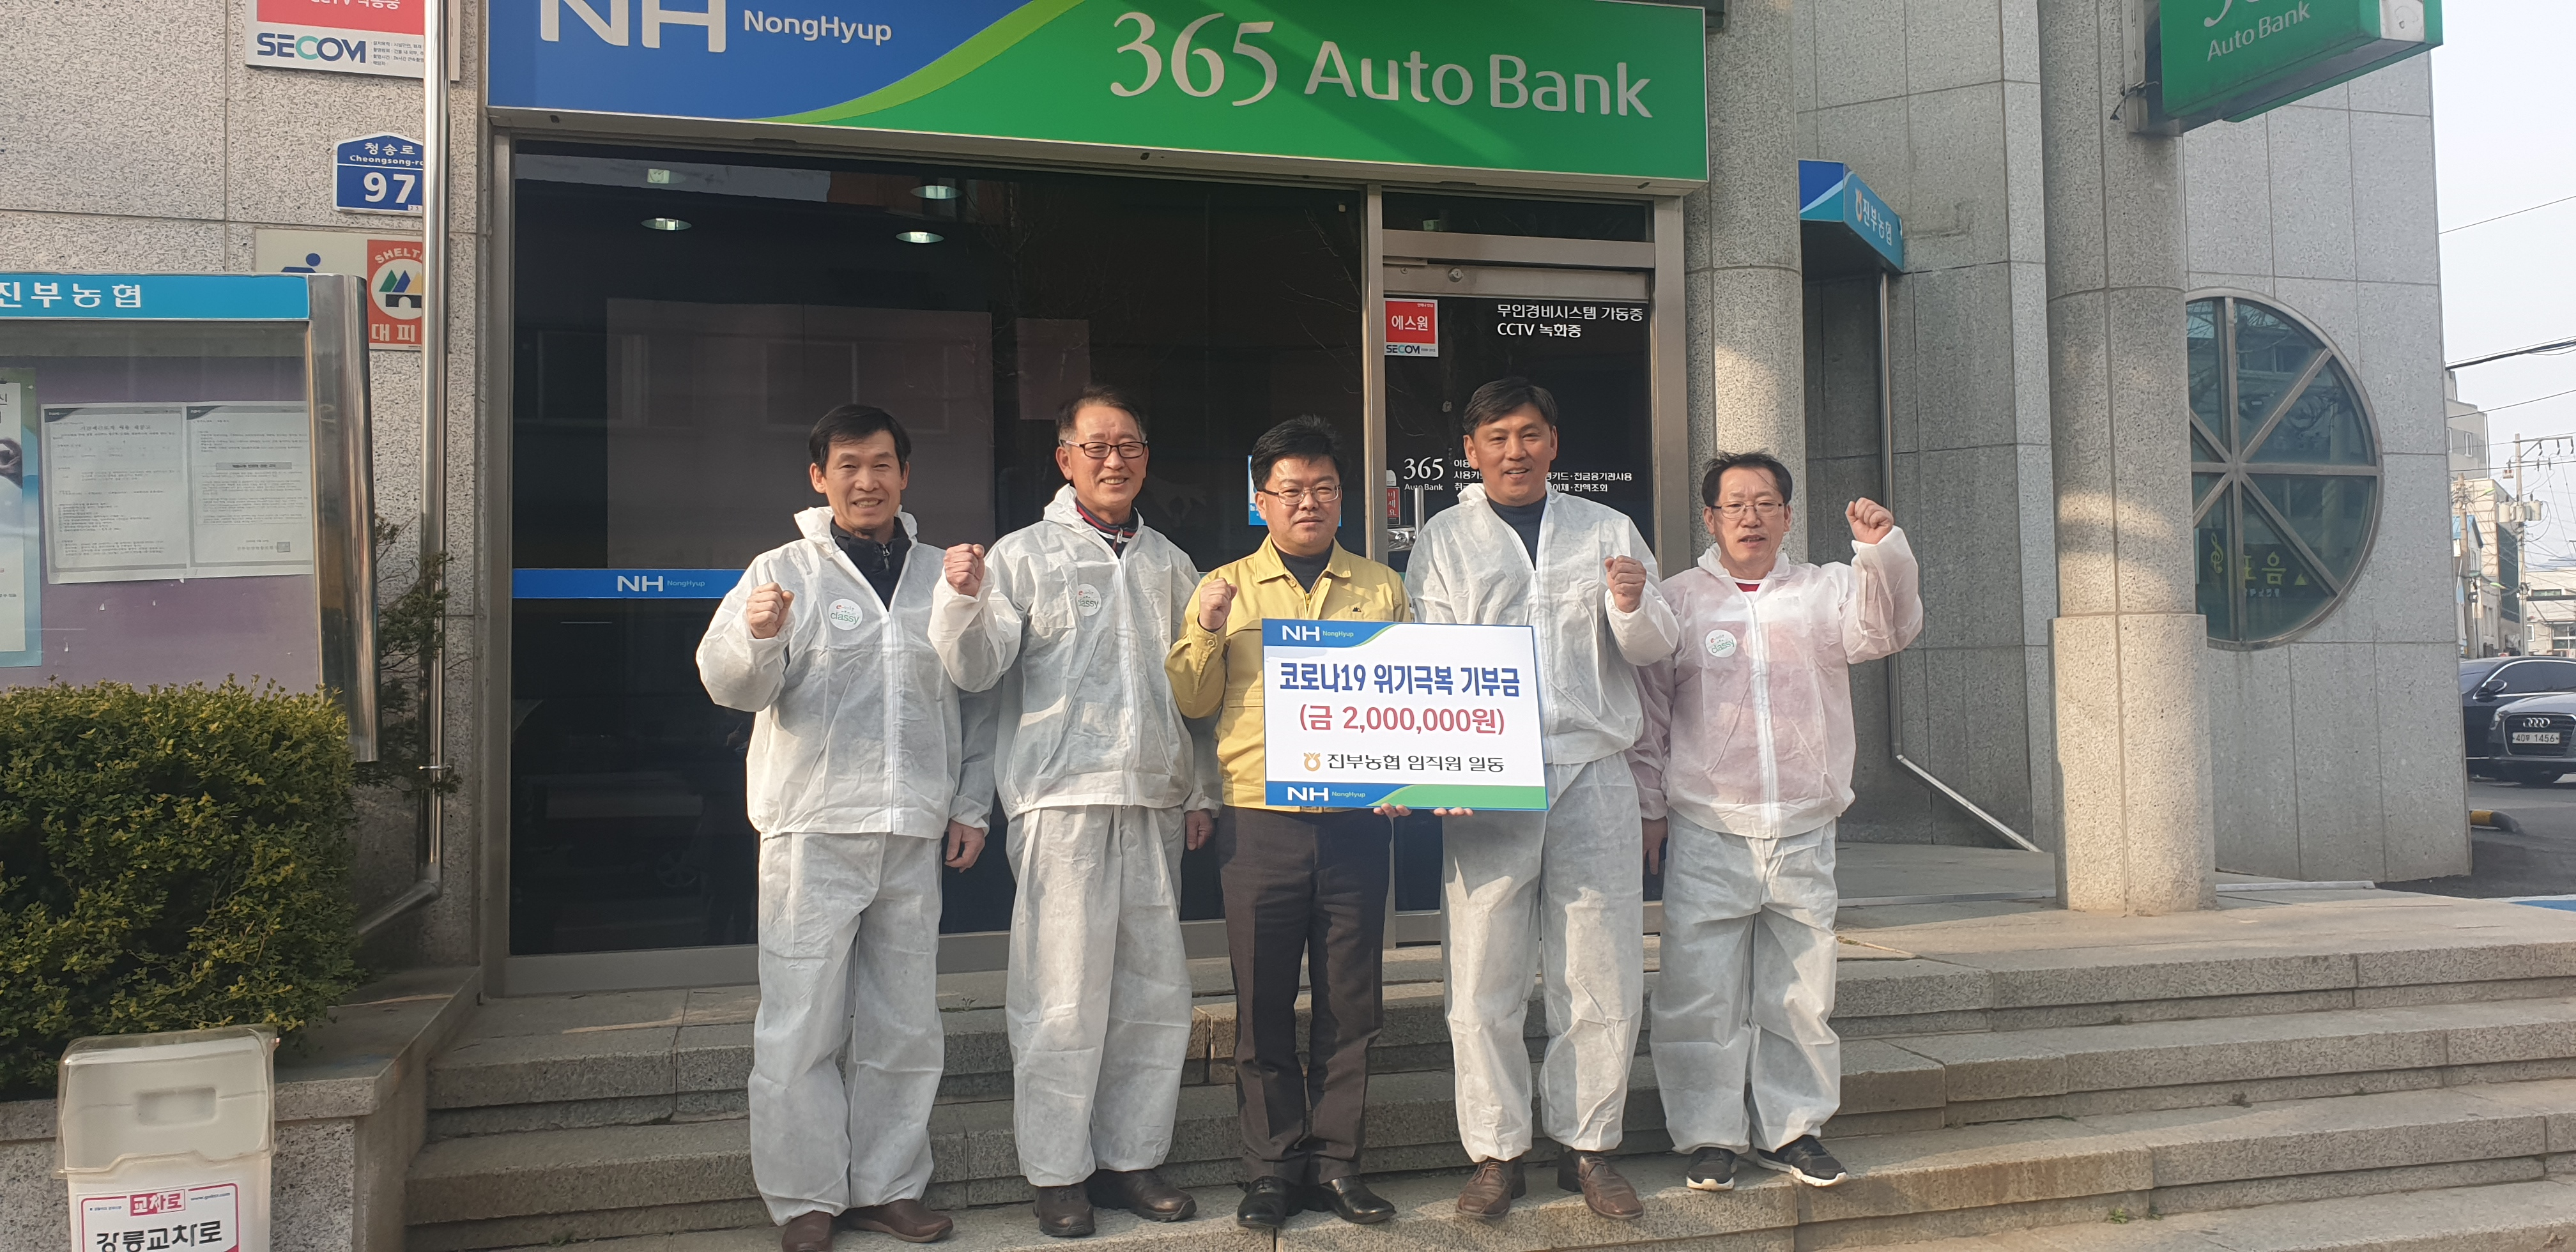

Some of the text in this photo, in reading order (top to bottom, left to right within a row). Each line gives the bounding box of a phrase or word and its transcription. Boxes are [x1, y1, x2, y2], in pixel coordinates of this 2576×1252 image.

[540, 0, 893, 53] NH NongHyup
[2207, 29, 2255, 61] Auto
[2258, 3, 2311, 39] Bank
[257, 33, 366, 64] SECOM
[1110, 11, 1653, 119] 365 Auto Bank
[365, 142, 415, 156] 청송로
[364, 172, 415, 204] 97
[1862, 198, 1892, 247] 진부농협
[0, 282, 141, 309] 진부농협
[1497, 304, 1643, 321] 무인경비시스템 가동중
[1392, 315, 1428, 331] 에스원
[1497, 323, 1582, 338] CCTV 녹화중
[1386, 344, 1420, 354] SECOM
[1403, 457, 1444, 480] 365
[1453, 471, 1482, 479] 사용카
[617, 575, 705, 592] NH NongHyup
[830, 611, 860, 625] classy
[1282, 625, 1321, 641] NH
[1711, 638, 1735, 653] classy
[1280, 662, 1520, 698] 코로나19 위기극복 기부금
[1300, 703, 1505, 735] (금 2,000,000원)
[2534, 734, 2555, 742] 1456
[1327, 753, 1505, 773] 진부농협 임직원 일동
[1287, 786, 1330, 802] NH
[133, 1192, 183, 1214] 교차로
[96, 1220, 222, 1252] 강릉교차로
